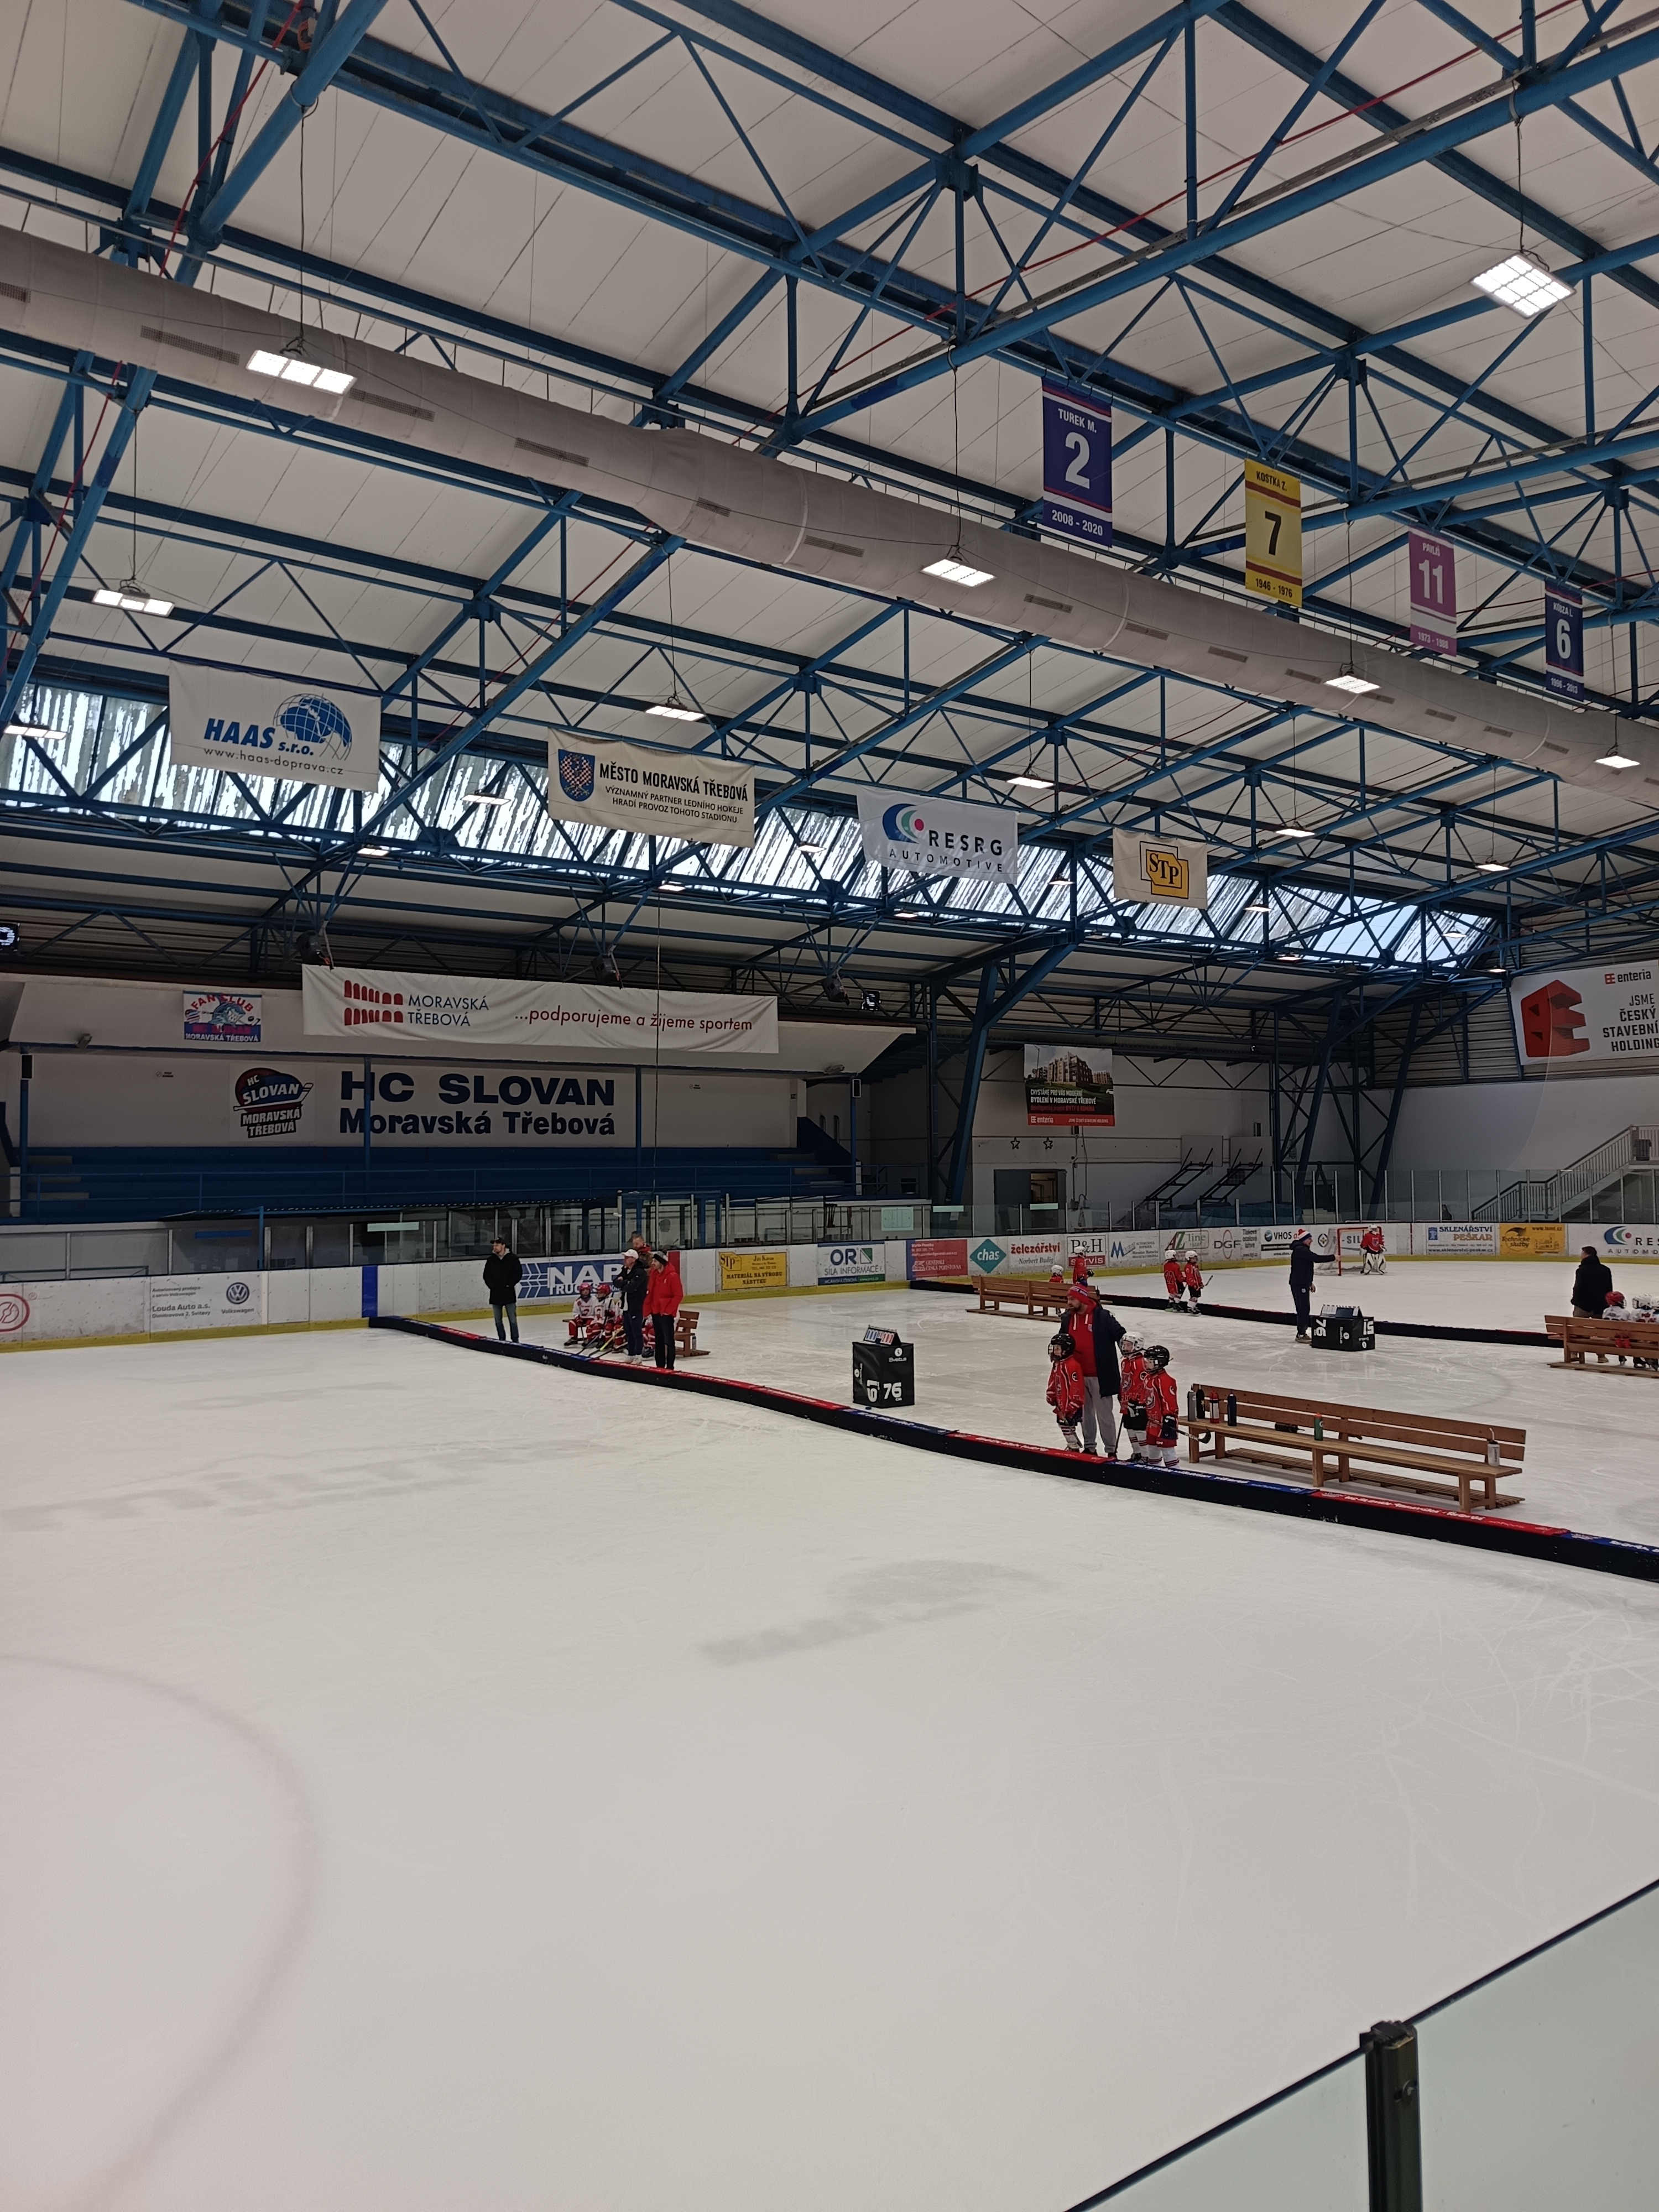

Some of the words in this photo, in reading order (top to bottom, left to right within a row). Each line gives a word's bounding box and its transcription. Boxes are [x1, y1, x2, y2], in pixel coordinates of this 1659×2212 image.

[1058, 408, 1085, 428] TUREK
[1088, 420, 1097, 433] M.
[1065, 432, 1090, 489] 2
[1256, 471, 1281, 488] KOSTKA
[1282, 481, 1287, 492] Z.
[1052, 509, 1073, 526] 2008
[1082, 519, 1103, 536] 2020
[1265, 510, 1281, 556] 7
[1256, 578, 1271, 591] 1946
[1278, 585, 1292, 598] 1976
[1418, 559, 1443, 604] 11
[1557, 618, 1571, 659] 6
[204, 718, 275, 749] HAAS
[278, 742, 314, 756] s.r.o.
[204, 748, 343, 775] www.haas-doprava.cz
[599, 761, 638, 784] MĚSTO
[643, 771, 700, 795] MORAVSKÁ
[703, 779, 748, 801] TŘEBOVÁ
[606, 785, 648, 800] VÝZNAMNÝ
[650, 793, 682, 805] PARTNER
[684, 799, 716, 811] LEDNÍHO
[717, 804, 743, 815] HOKEJE
[613, 797, 637, 808] HRADÍ
[639, 802, 669, 813] PROVOZ
[670, 807, 700, 818] TOHOTO
[701, 812, 737, 823] STADIONU
[929, 830, 1002, 855] RESRG
[889, 848, 1002, 872] AUTOMOTIVE
[1150, 853, 1179, 884] STP
[1618, 969, 1651, 982] enteria
[191, 994, 216, 1009] FAN
[220, 993, 253, 1011] CLUB
[409, 994, 489, 1010] MORAVSKÁ
[1629, 993, 1655, 1006] JSME
[408, 1009, 471, 1026] TŘEBOVÁ
[515, 1005, 631, 1027] ...podporujeme
[636, 1016, 645, 1026] a
[650, 1013, 695, 1031] žijeme
[700, 1018, 752, 1033] sportem
[1620, 1005, 1656, 1022] ČESKÝ
[185, 1032, 224, 1041] MORAVSKÁ
[1603, 1021, 1659, 1038] STAVEBNÍ
[247, 1074, 259, 1086] HC
[341, 1071, 414, 1102] HC
[439, 1073, 614, 1106] SLOVAN
[243, 1084, 299, 1105] SLOVAN
[243, 1107, 300, 1125] MORAVSKÁ
[340, 1108, 491, 1134] Moravská
[503, 1111, 615, 1135] Třebová
[249, 1120, 294, 1136] TŘEBOVÁ
[1011, 1242, 1060, 1255] železářství
[1071, 1238, 1103, 1254] P&H
[1165, 1232, 1185, 1250] AZ
[1214, 1240, 1241, 1249] DGF
[1636, 1237, 1659, 1245] RE
[830, 1249, 857, 1265] OR
[977, 1249, 999, 1261] chas
[1070, 1256, 1103, 1266] srvis
[547, 1264, 624, 1288] NAP
[152, 1304, 175, 1312] Louda
[1316, 1319, 1327, 1337] 76
[883, 1383, 902, 1399] 76
